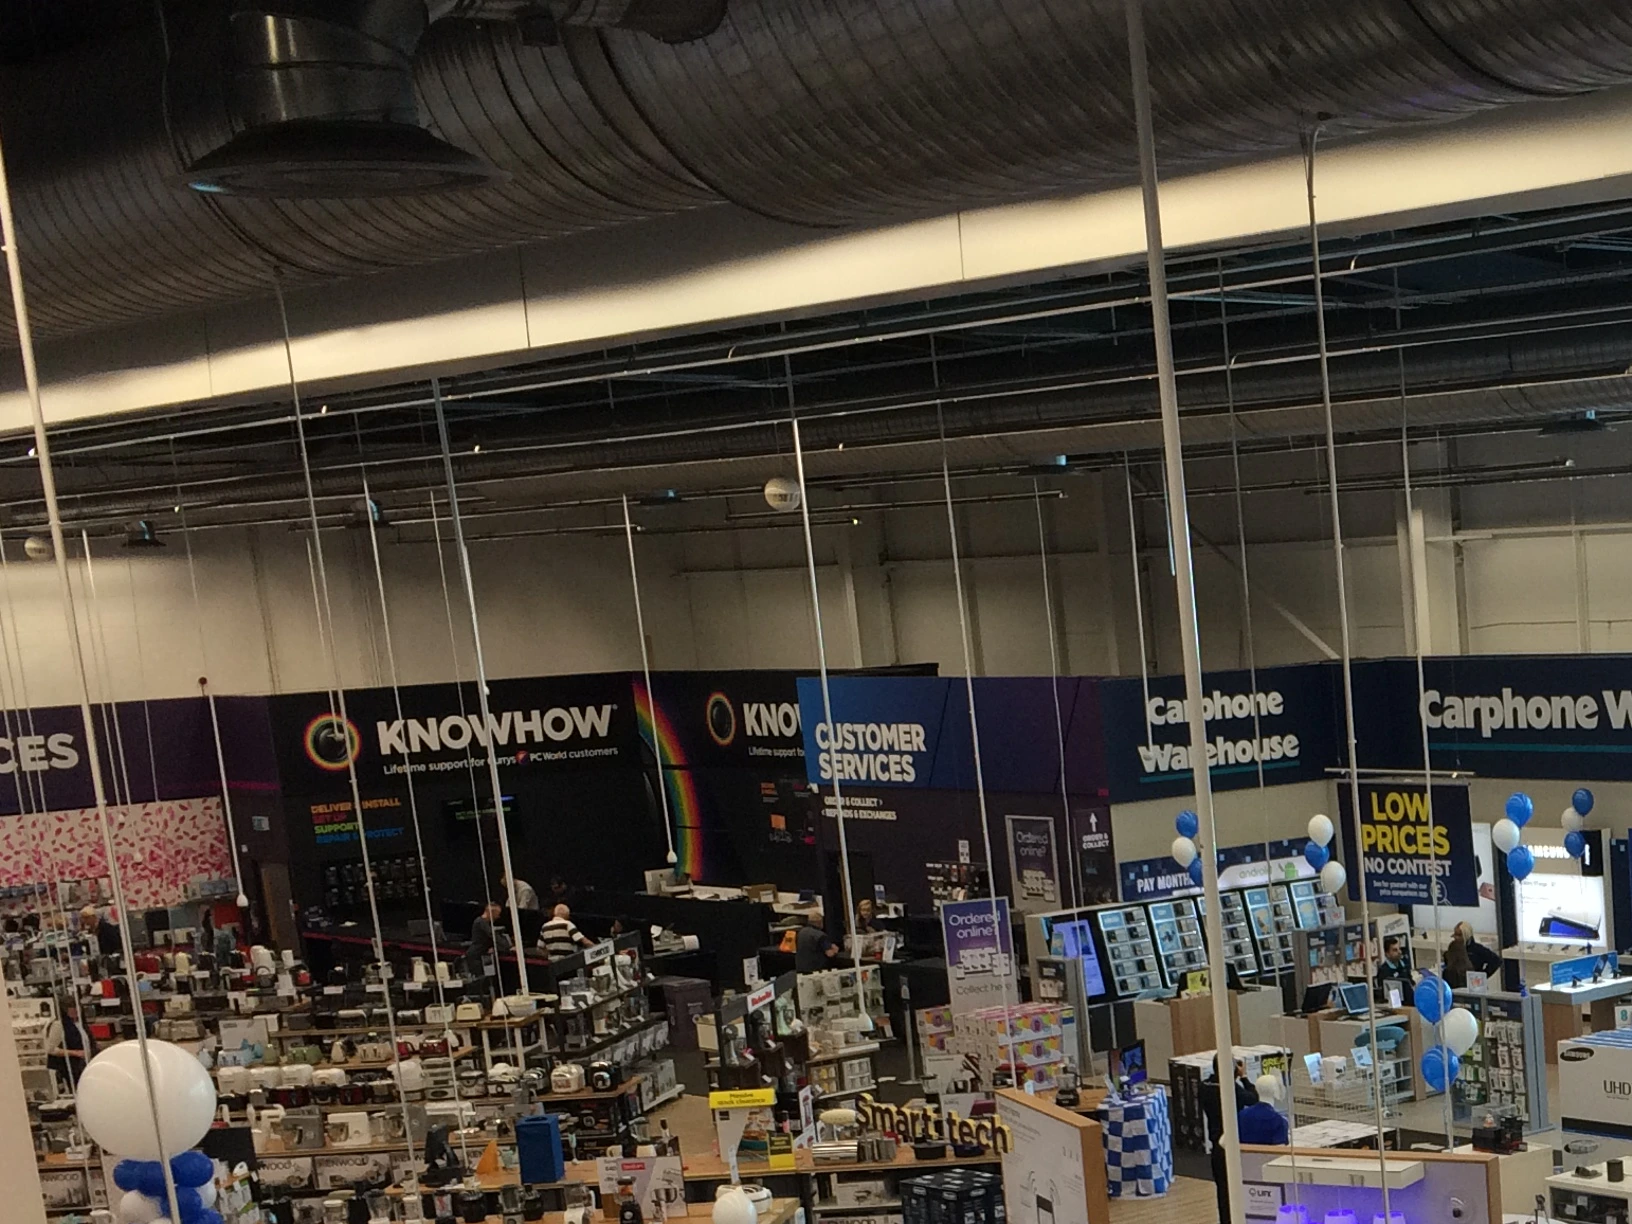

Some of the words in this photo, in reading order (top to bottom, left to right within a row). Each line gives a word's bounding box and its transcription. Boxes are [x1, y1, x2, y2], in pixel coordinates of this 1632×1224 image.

[743, 702, 803, 738] KNO
[1422, 687, 1599, 738] Carphone
[376, 704, 612, 754] KNOWHOW
[815, 722, 926, 752] CUSTOMER
[383, 762, 426, 775] Lifetme
[429, 758, 469, 773] support
[470, 757, 485, 768] for
[489, 753, 517, 768] urrys
[530, 752, 542, 762] PC
[543, 750, 568, 761] World
[569, 747, 618, 759] customers
[818, 752, 916, 783] SERVICES
[1371, 791, 1430, 822] LOW
[1082, 838, 1110, 850] COLLECT
[1360, 823, 1450, 856] PRICES
[1523, 843, 1572, 860] AMSUN
[1364, 856, 1385, 874] NO
[1387, 857, 1452, 877] CONTEST
[1136, 877, 1155, 893] PAY
[991, 983, 1013, 993] hee
[855, 1092, 939, 1142] Smart
[946, 1109, 1014, 1154] tech
[316, 1155, 369, 1168] KENWOOD
